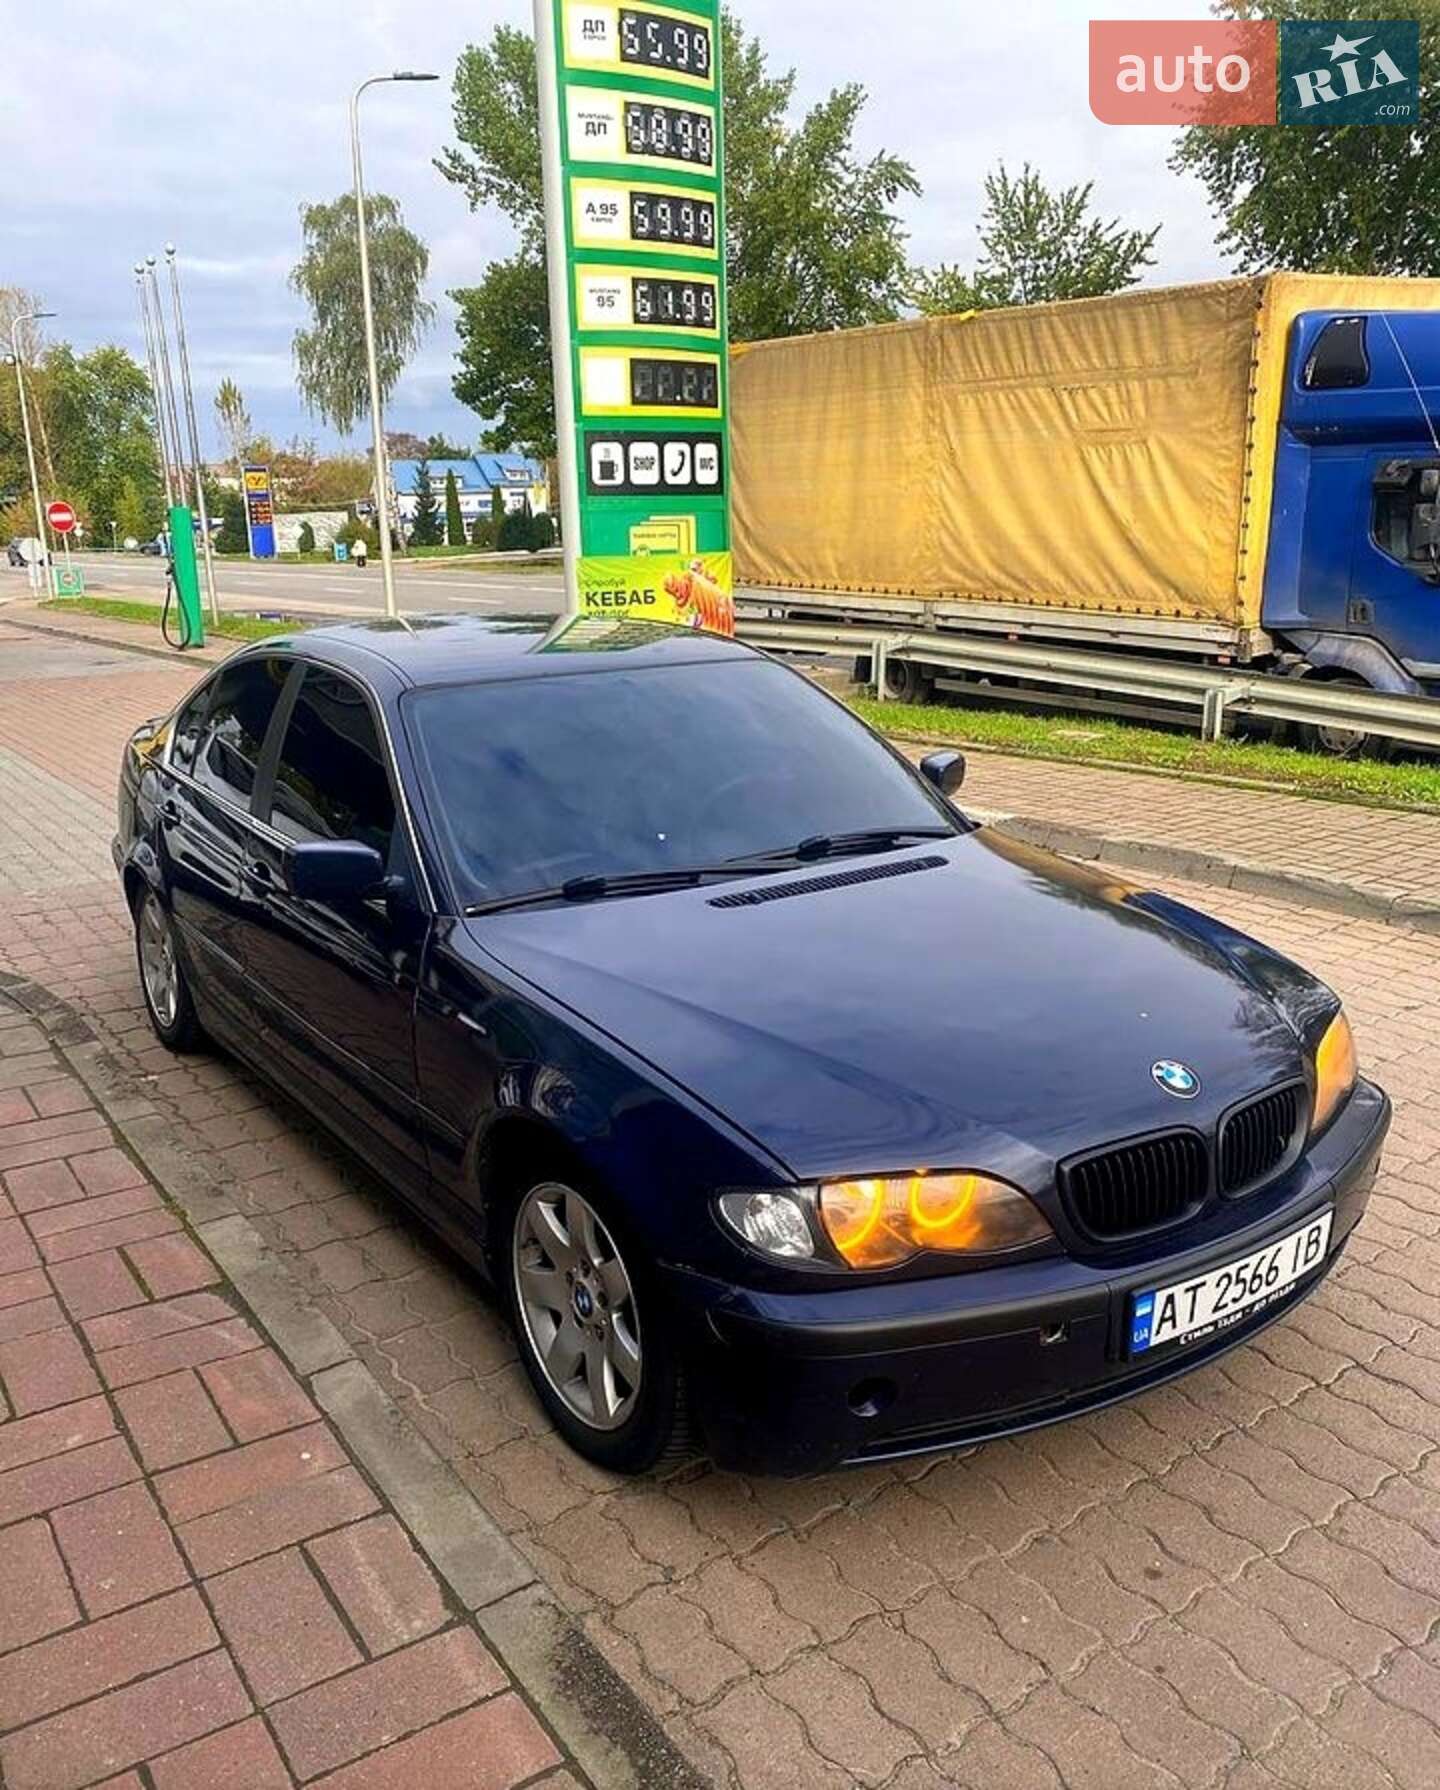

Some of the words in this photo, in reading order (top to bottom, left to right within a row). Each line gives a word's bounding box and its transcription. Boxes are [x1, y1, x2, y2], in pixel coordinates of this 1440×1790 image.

[582, 19, 605, 34] ДП
[622, 14, 708, 70] 55.99
[585, 121, 607, 136] ДП
[599, 203, 618, 216] 95
[633, 200, 713, 242] 59.99
[597, 295, 615, 308] 95
[635, 282, 713, 322] 61.99
[633, 456, 656, 471] SHOP
[699, 457, 715, 471] WC
[585, 589, 656, 607] КЕБАБ
[1155, 1281, 1206, 1336] AT
[1212, 1247, 1281, 1314] 2566
[1292, 1224, 1322, 1273] IB
[1133, 1328, 1149, 1343] UA
